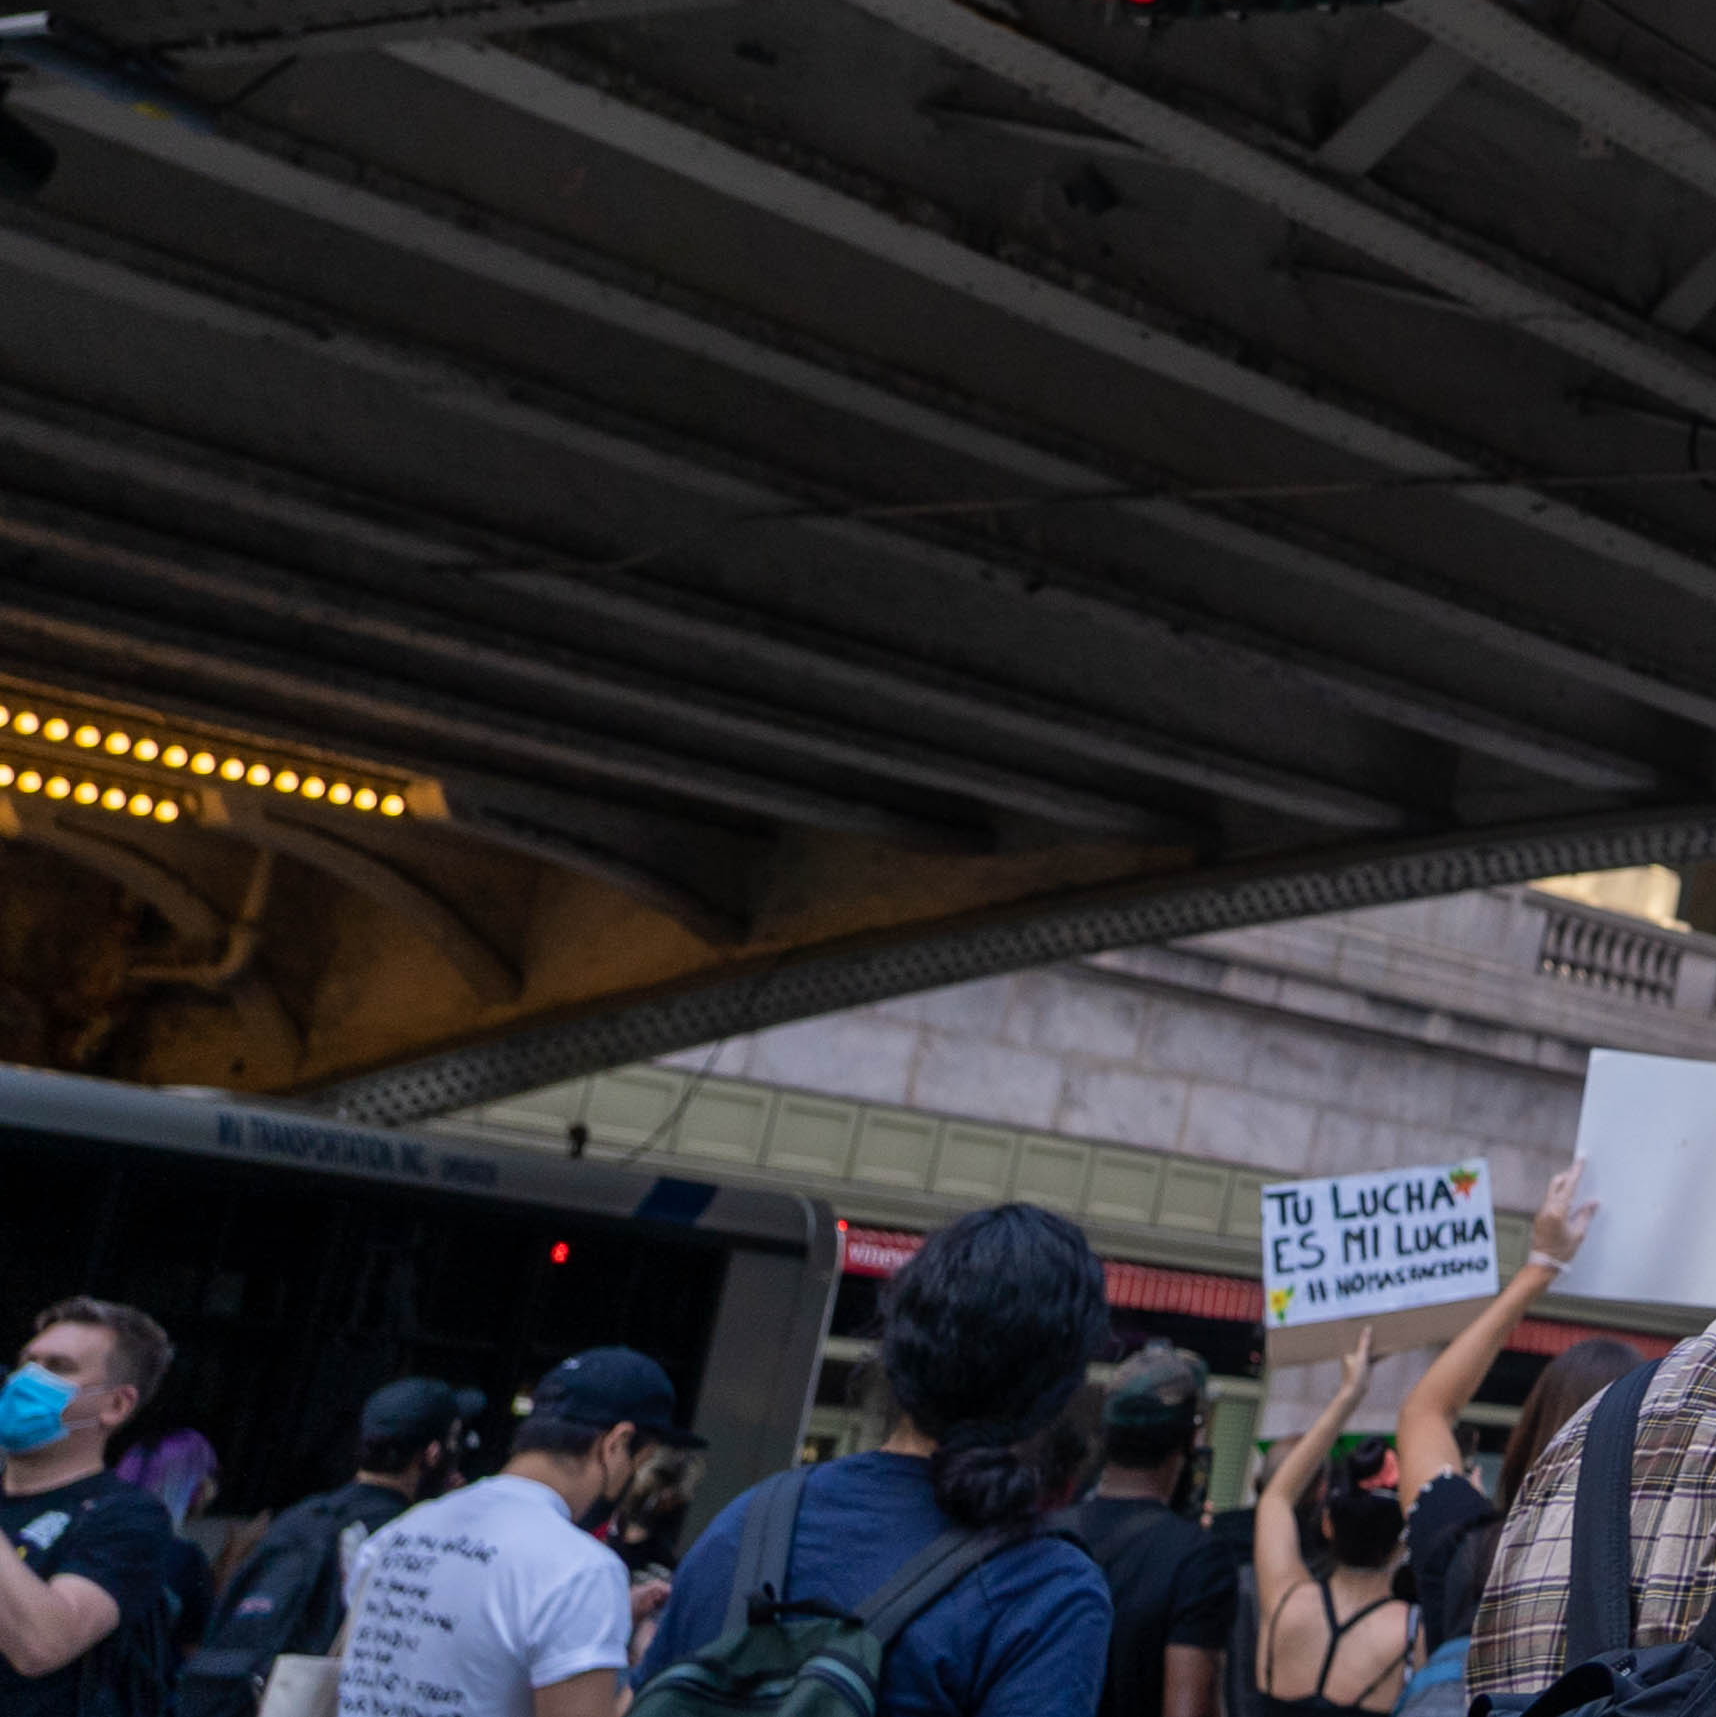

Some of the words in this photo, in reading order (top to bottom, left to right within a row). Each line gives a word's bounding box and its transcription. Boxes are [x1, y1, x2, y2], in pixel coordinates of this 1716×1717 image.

[1263, 1190, 1313, 1226] TU
[1330, 1178, 1456, 1220] LUCHA
[1272, 1230, 1326, 1275] ES
[1342, 1224, 1380, 1263] MI
[1394, 1216, 1489, 1256] LUCHA
